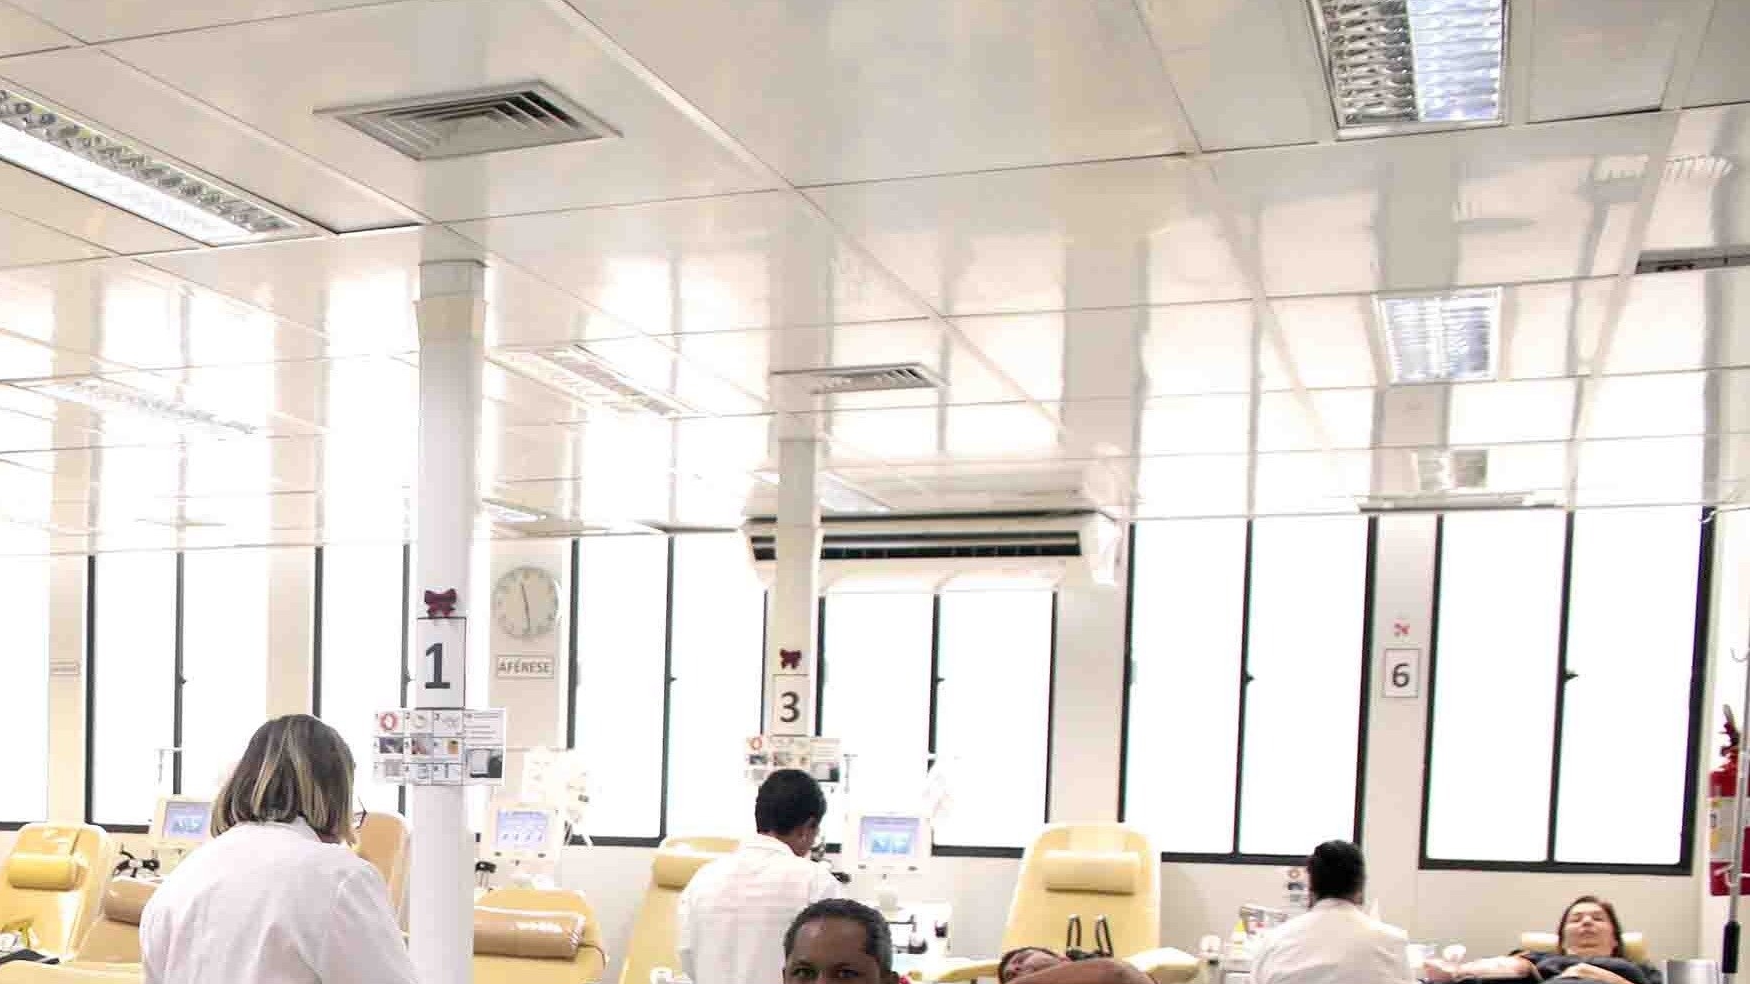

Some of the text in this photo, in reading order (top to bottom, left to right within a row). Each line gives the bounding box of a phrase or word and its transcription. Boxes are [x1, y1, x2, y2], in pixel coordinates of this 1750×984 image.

[425, 642, 451, 689] 1
[498, 657, 553, 673] AFÉRESE
[1392, 662, 1410, 688] 6
[779, 691, 800, 723] 3
